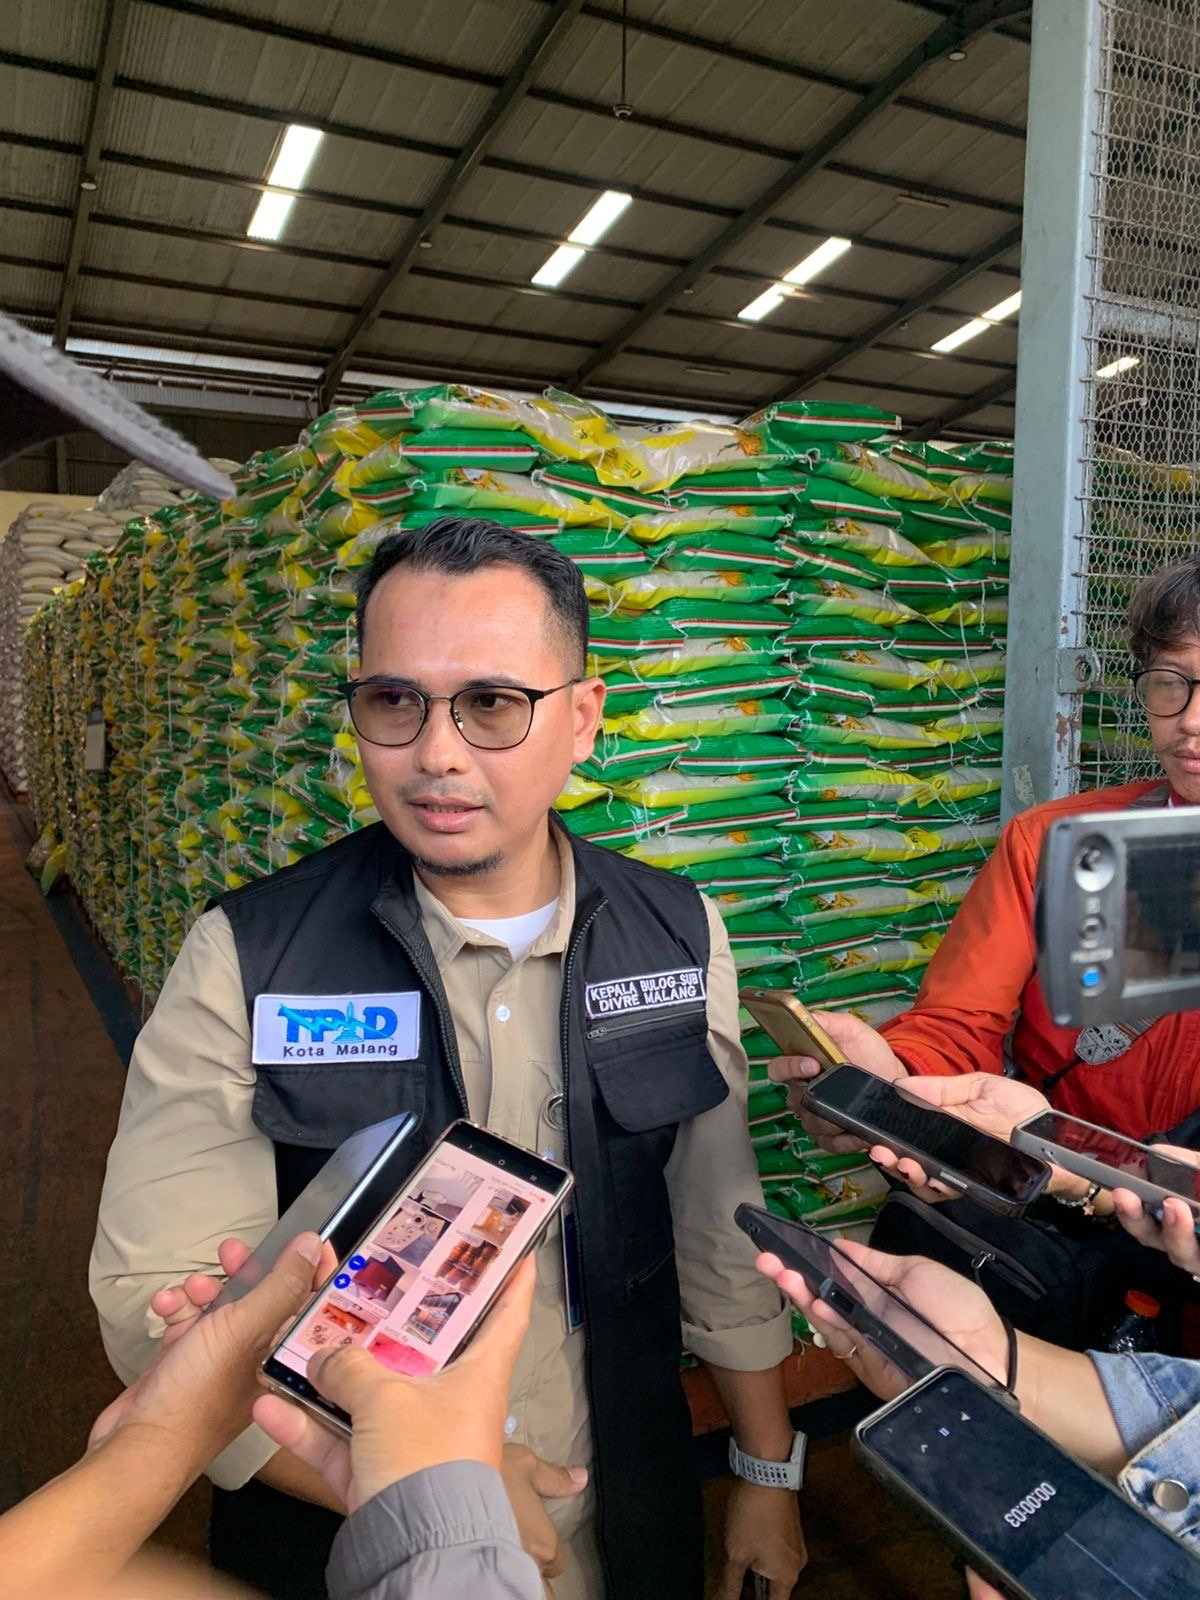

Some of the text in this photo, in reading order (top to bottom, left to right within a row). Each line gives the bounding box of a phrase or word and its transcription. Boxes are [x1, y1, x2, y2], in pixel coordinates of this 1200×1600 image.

[590, 982, 637, 1001] KEPALA
[640, 976, 675, 992] BULOG
[598, 986, 697, 1012] DIVRE MALANG
[283, 1044, 399, 1058] Kota Malang
[1004, 1482, 1056, 1528] 00:00:03
